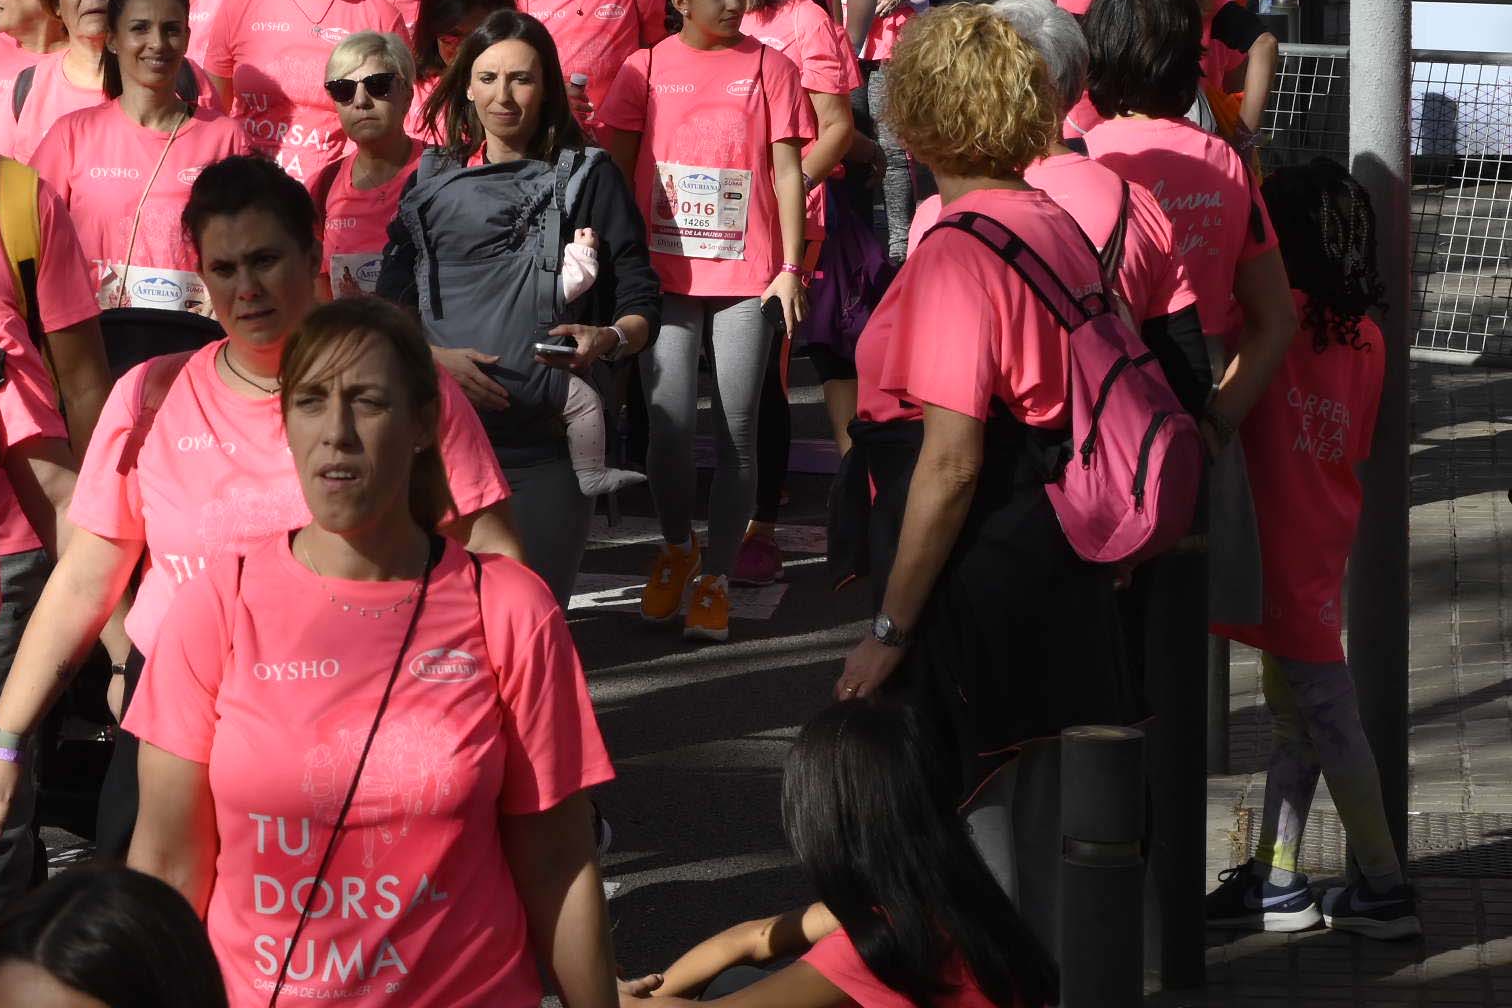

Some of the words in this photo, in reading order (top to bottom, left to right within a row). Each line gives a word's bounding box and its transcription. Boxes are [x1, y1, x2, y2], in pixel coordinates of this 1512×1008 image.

[251, 22, 290, 32] OYSHO
[654, 83, 696, 94] OYSHO
[89, 167, 140, 180] OYSHO
[682, 179, 719, 191] ASTURIANA
[683, 218, 711, 228] 14265
[138, 282, 180, 298] ASTURIANA
[254, 658, 341, 682] OYSHO
[248, 812, 311, 855] TU
[254, 872, 448, 920] DORSAL
[254, 934, 409, 983] SUMA
[384, 982, 402, 994] 20
